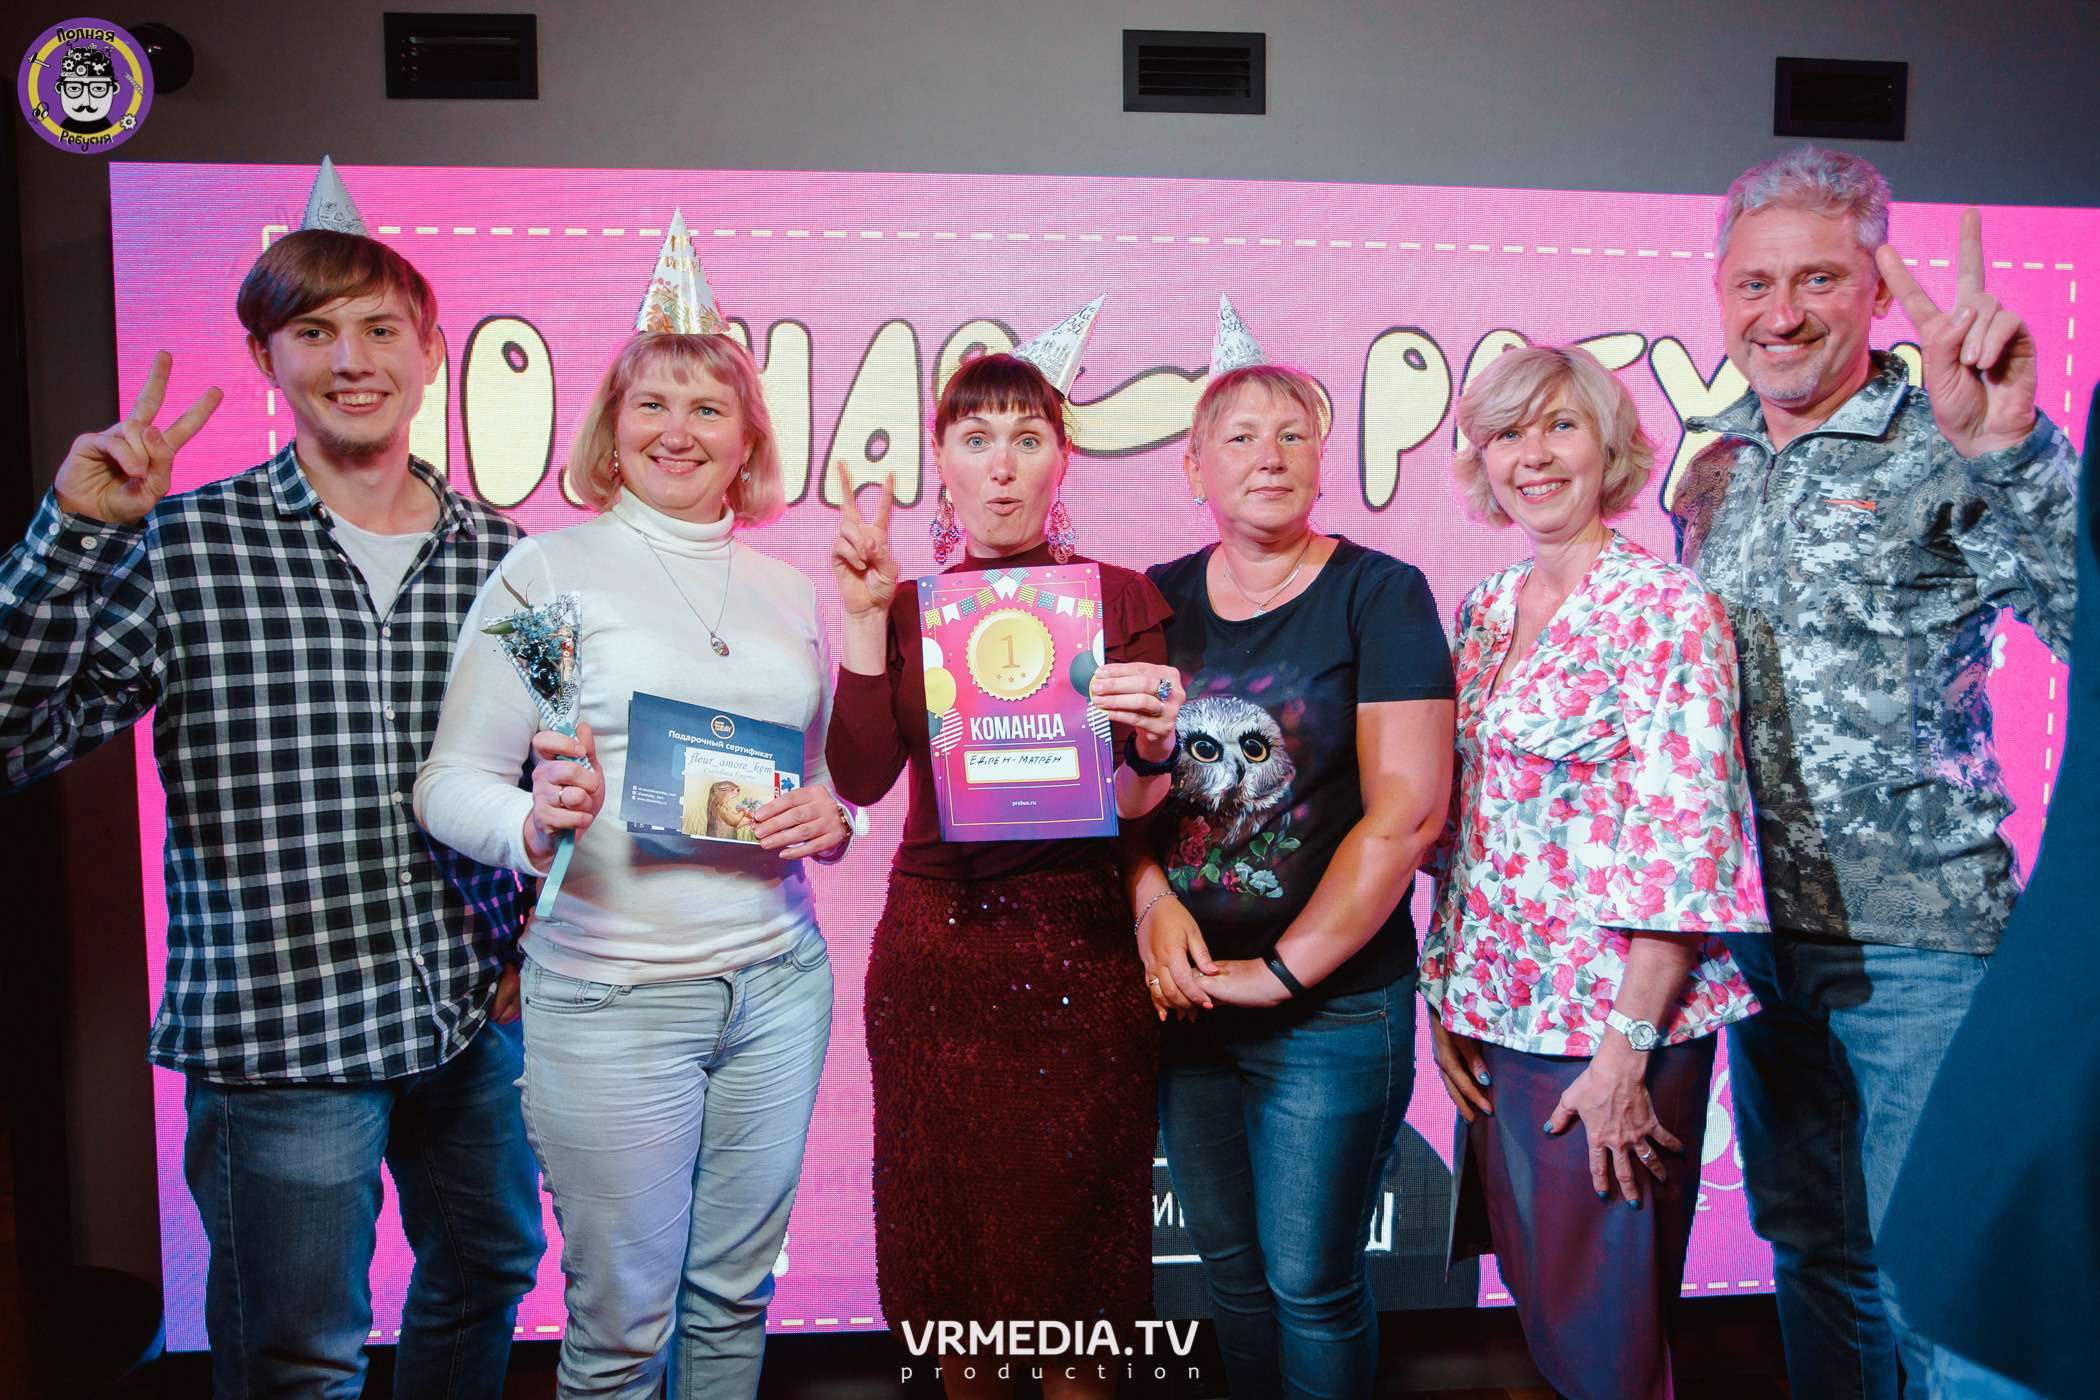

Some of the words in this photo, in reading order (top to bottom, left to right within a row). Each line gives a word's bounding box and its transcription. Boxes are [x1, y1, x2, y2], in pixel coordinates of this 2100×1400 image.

[1001, 634, 1021, 669] 1
[970, 713, 1066, 741] КОМАНДА
[668, 730, 724, 749] Подарочный
[725, 743, 774, 760] сертификат
[687, 752, 772, 775] fleur_amore_kem
